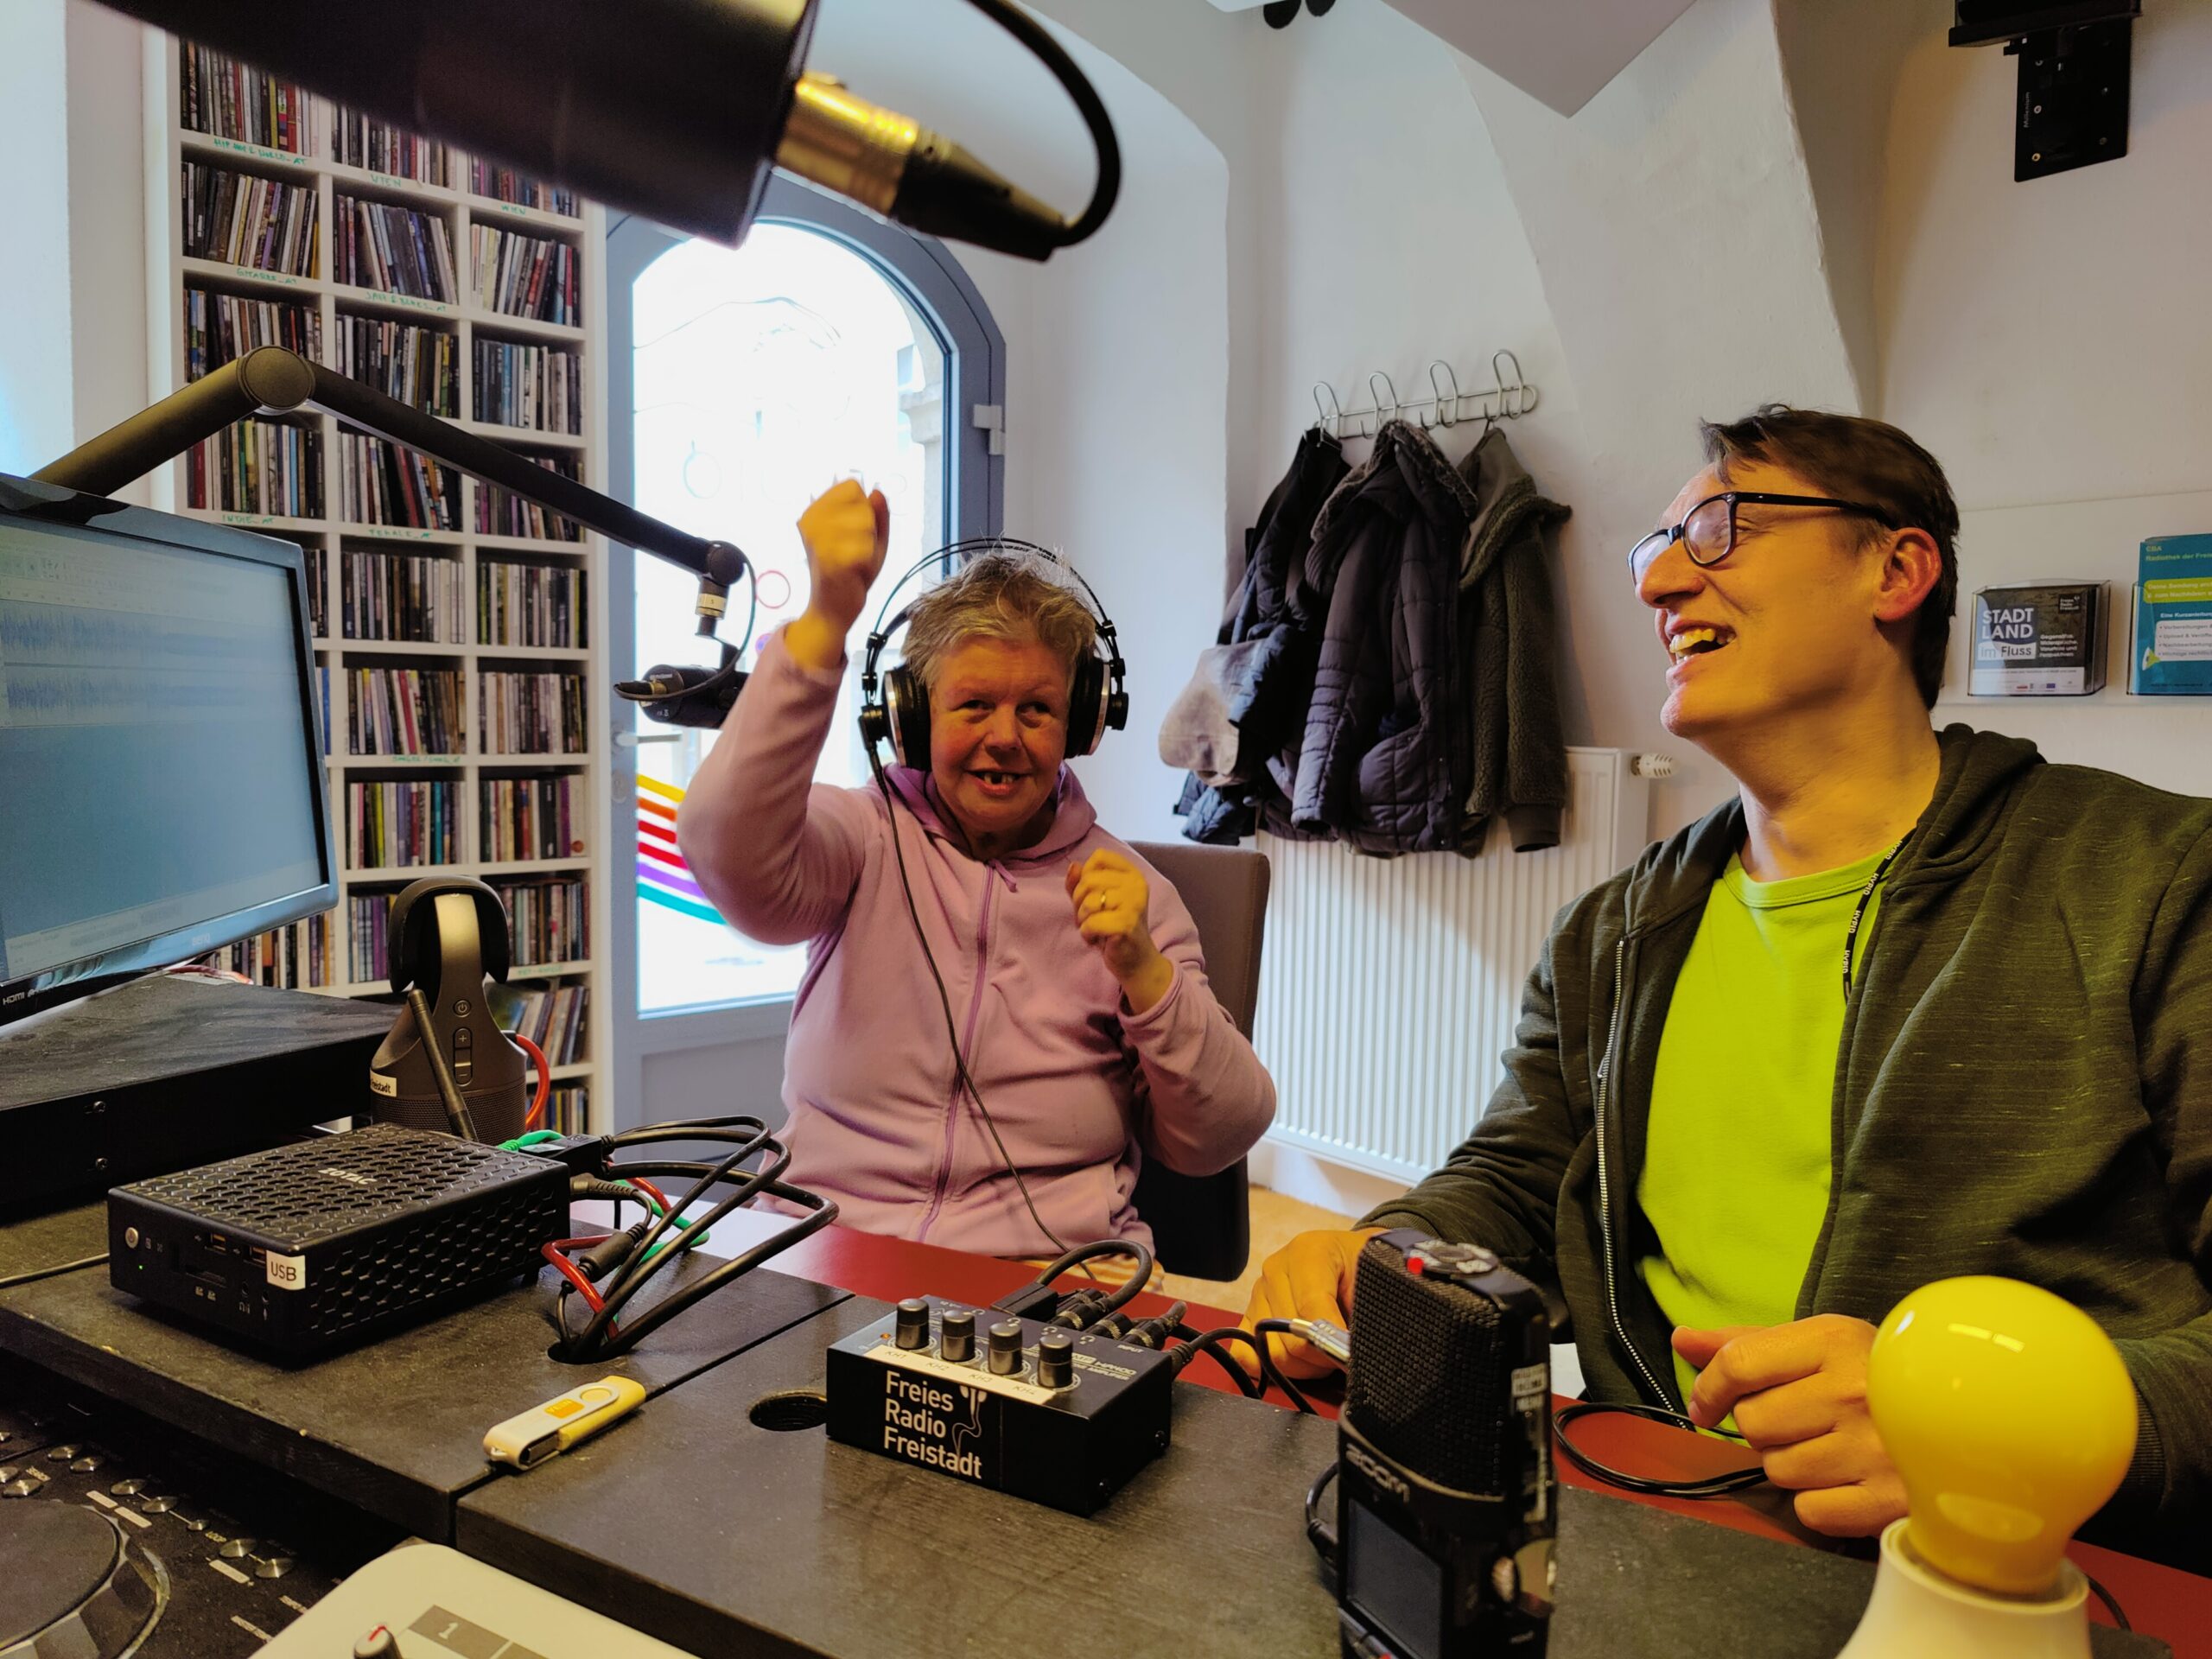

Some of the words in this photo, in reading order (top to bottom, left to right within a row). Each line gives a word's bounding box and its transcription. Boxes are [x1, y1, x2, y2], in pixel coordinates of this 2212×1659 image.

[2023, 92, 2031, 129] Millenium
[1982, 607, 2034, 624] STADT
[1981, 624, 2033, 639] LAND
[1980, 647, 1996, 658] im
[2000, 645, 2031, 658] Fluss
[317, 1167, 378, 1185] ZOTAC
[270, 1261, 297, 1281] USB
[1116, 1344, 1144, 1354] INPUT
[885, 1370, 954, 1413] Freies
[884, 1398, 947, 1439] Radio
[883, 1427, 982, 1480] Freistadt
[437, 1620, 460, 1641] 1
